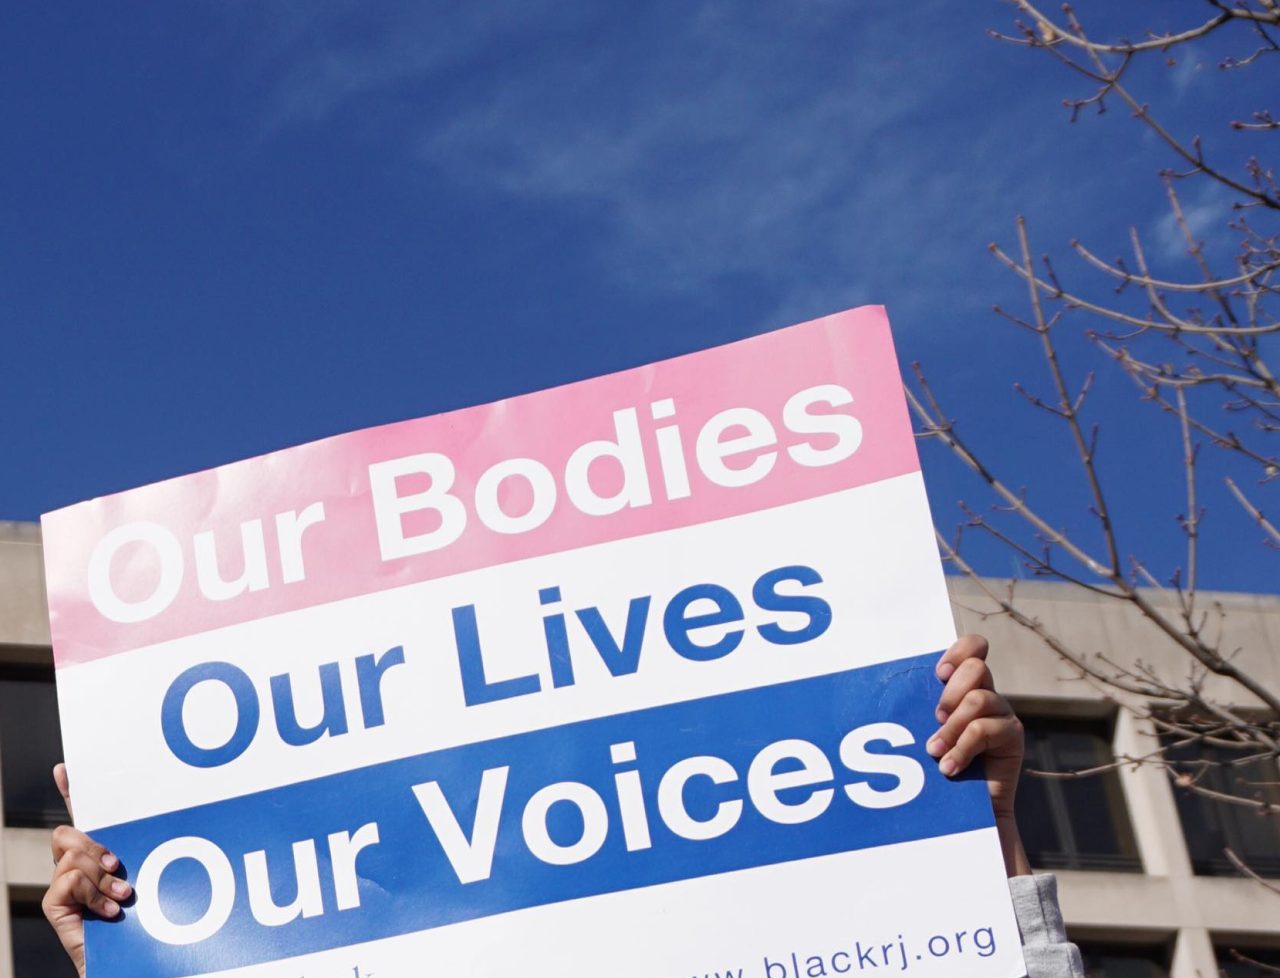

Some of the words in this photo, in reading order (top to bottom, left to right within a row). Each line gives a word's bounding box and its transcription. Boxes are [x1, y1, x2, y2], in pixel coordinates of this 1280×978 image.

[88, 502, 325, 623] Our
[368, 384, 863, 562] Bodies
[161, 646, 405, 768] Our
[453, 565, 832, 706] Lives
[133, 823, 379, 945] Our
[412, 723, 924, 884] Voices
